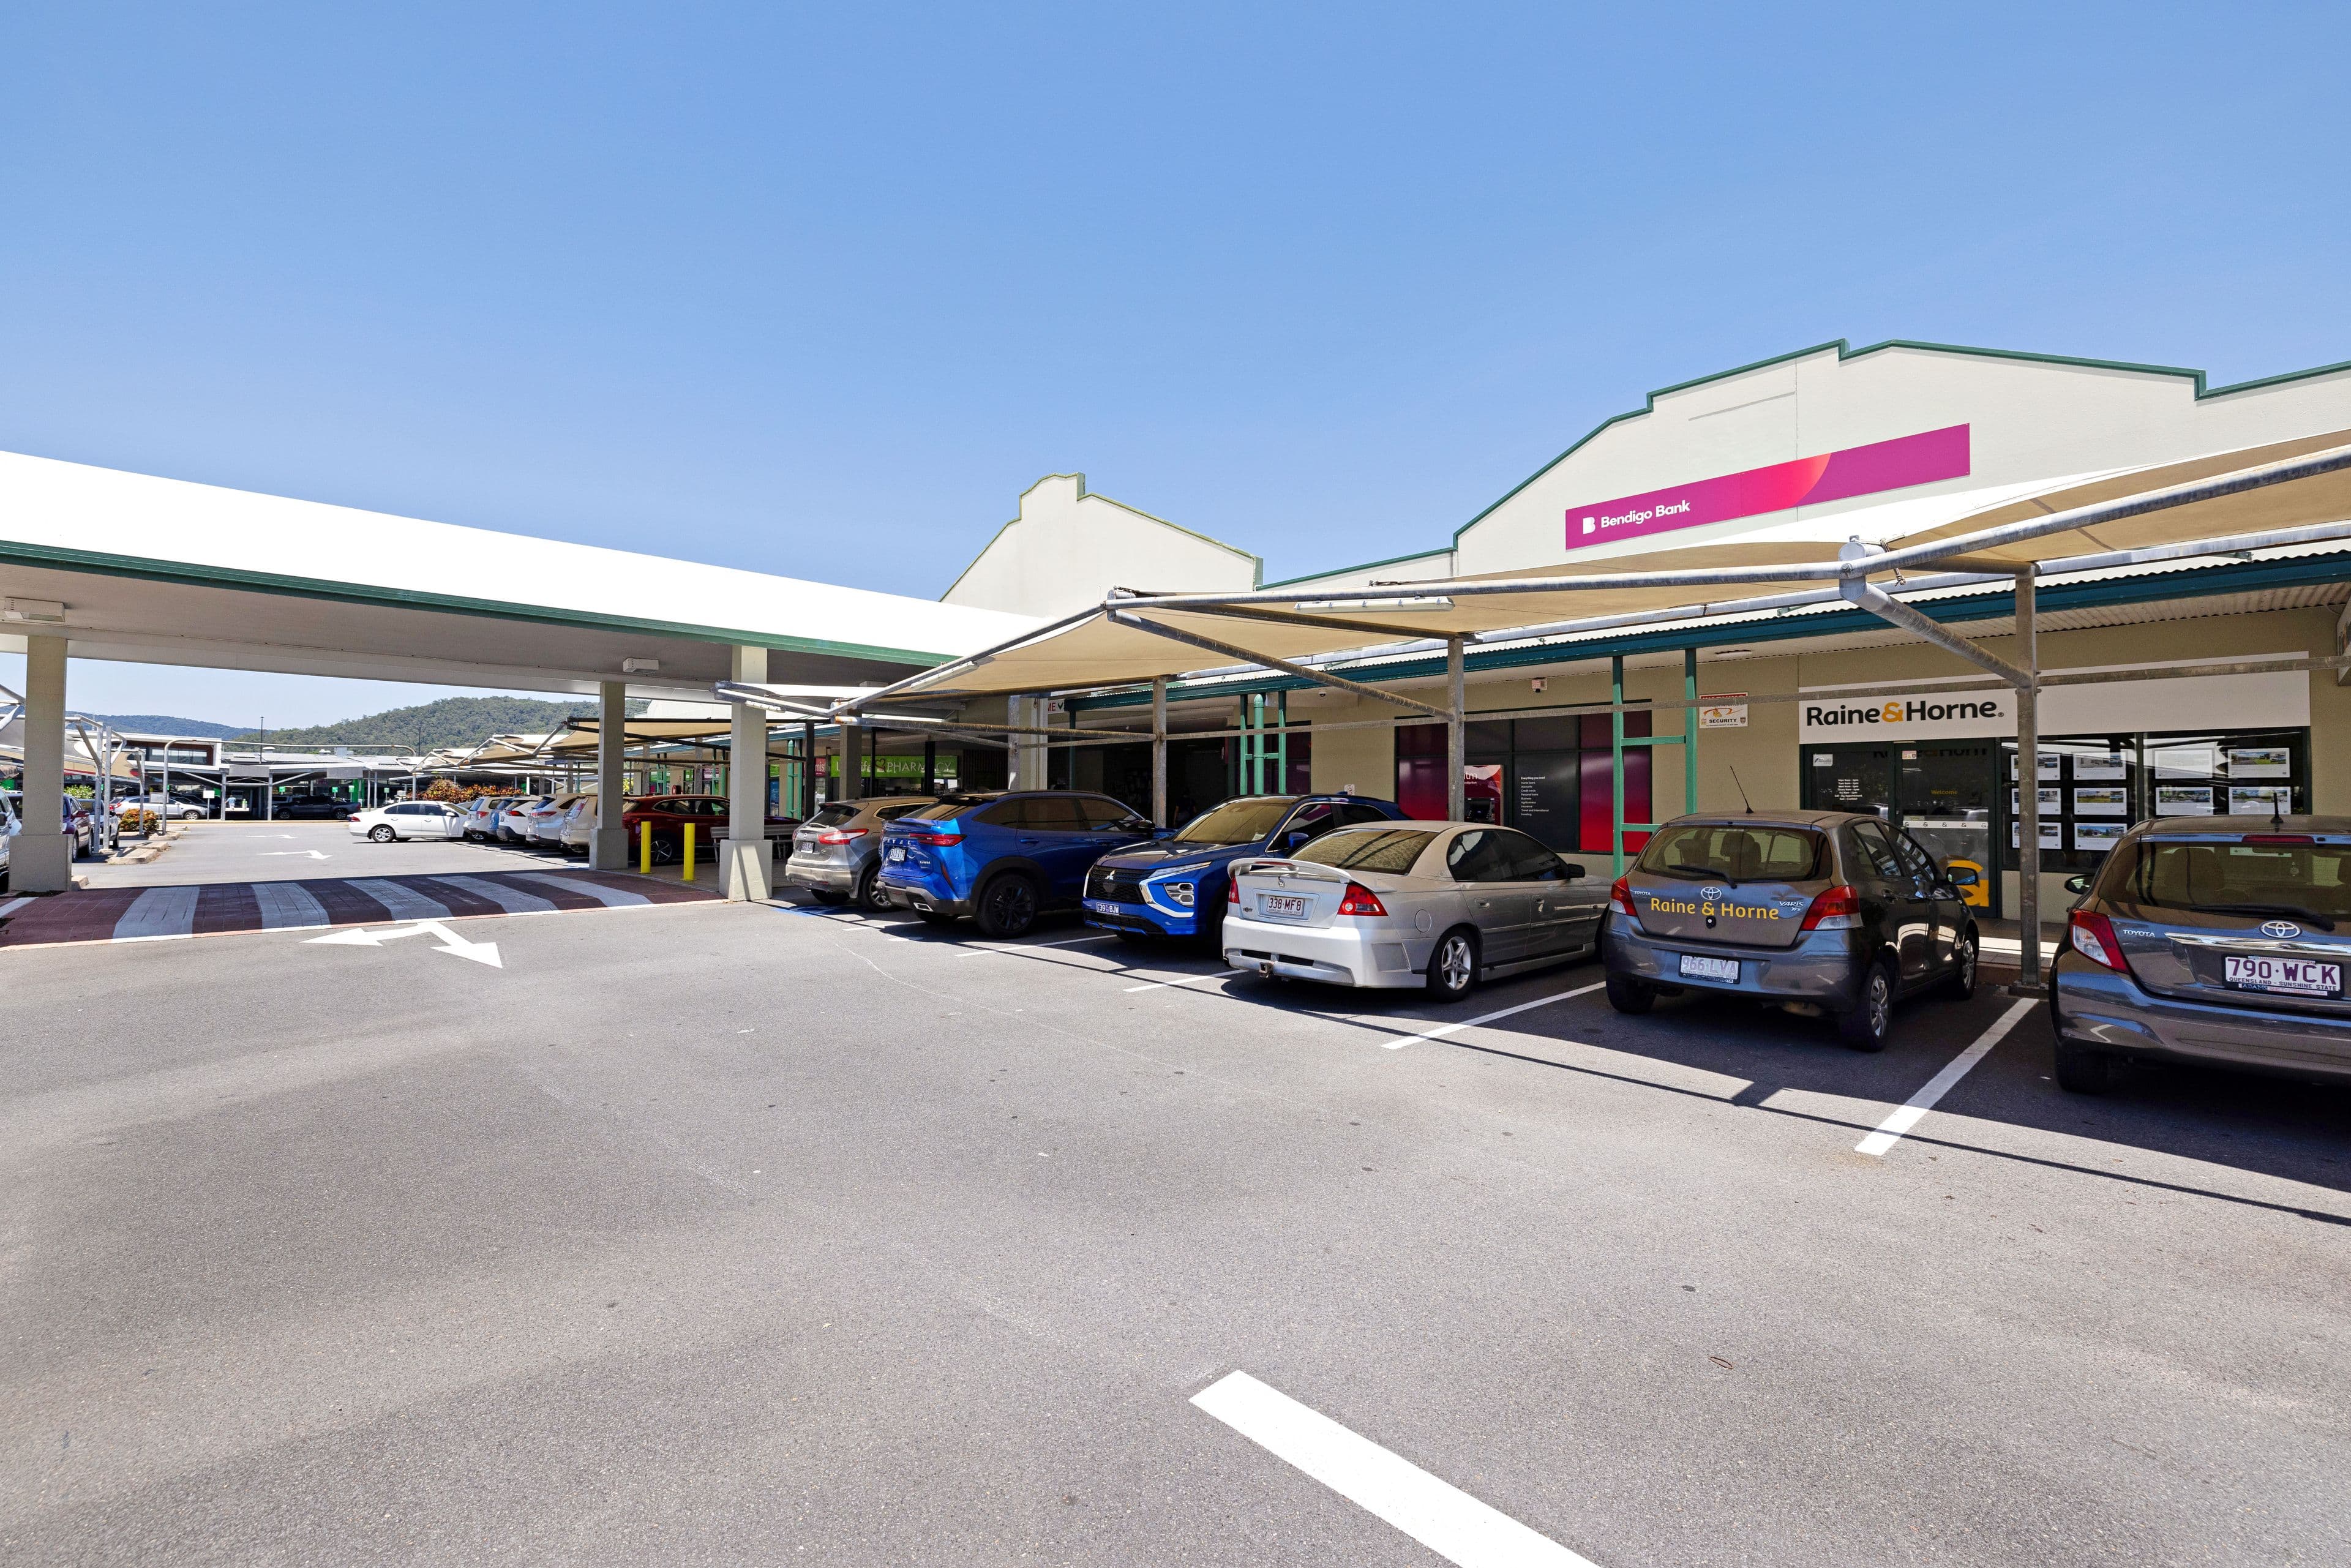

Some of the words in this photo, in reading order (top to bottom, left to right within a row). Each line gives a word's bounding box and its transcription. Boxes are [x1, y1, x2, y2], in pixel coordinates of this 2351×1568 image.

[1601, 510, 1652, 528] Bendigo
[1655, 500, 1690, 517] Bank
[1651, 898, 1695, 914] Raine
[1701, 902, 1715, 915] &
[1721, 902, 1779, 920] Horne
